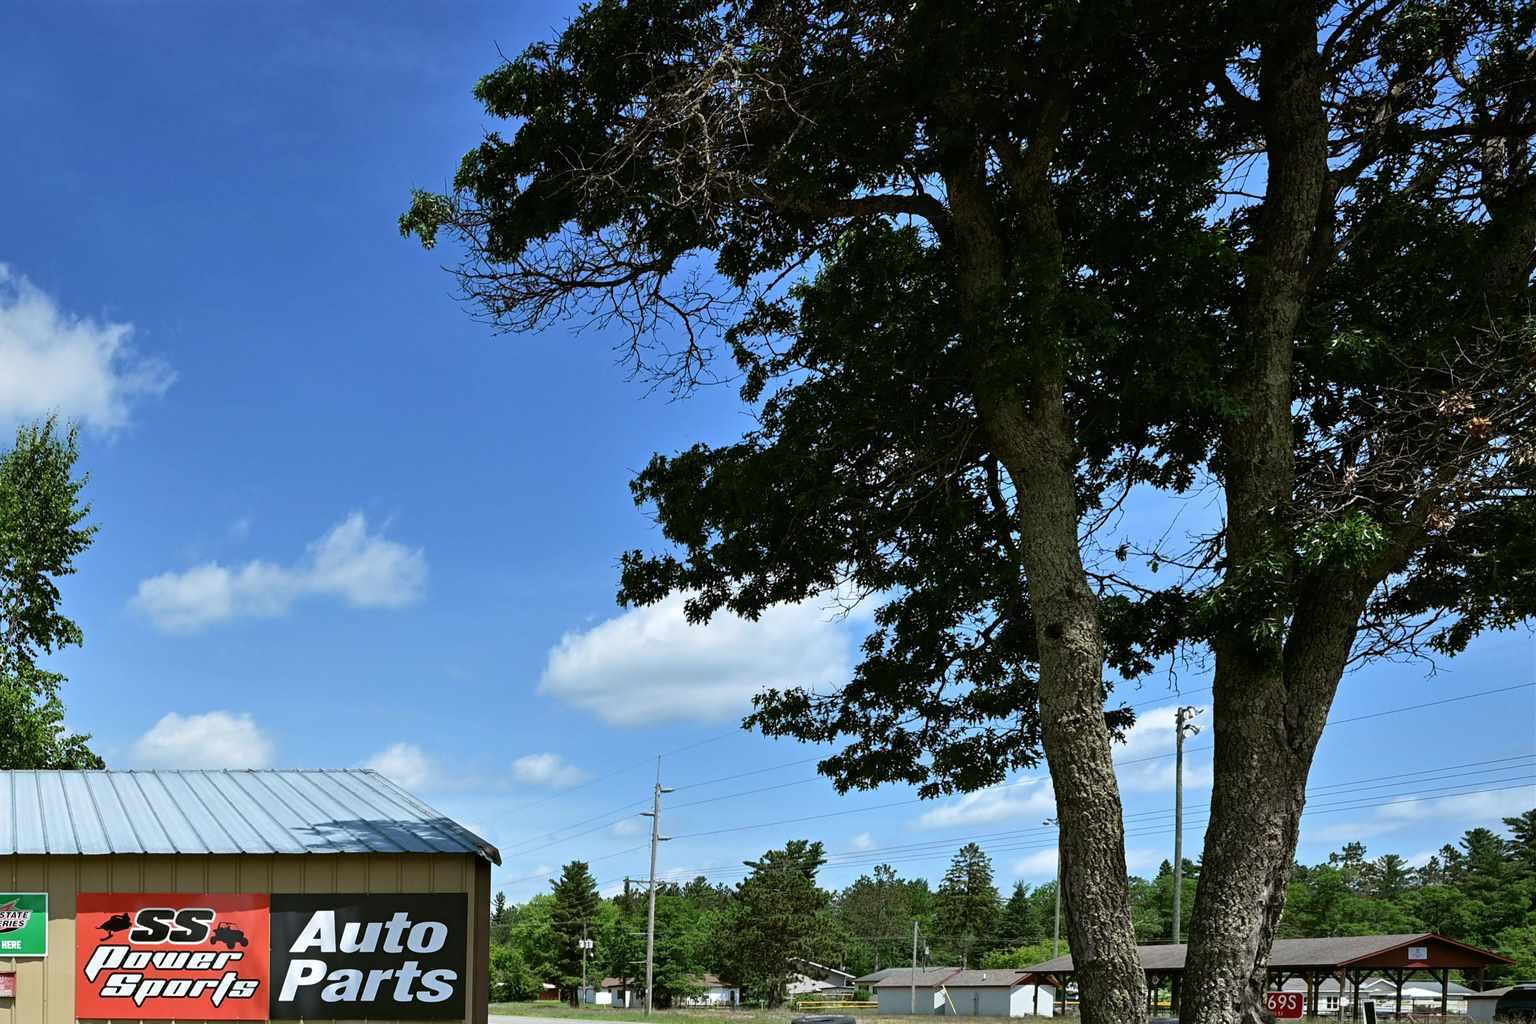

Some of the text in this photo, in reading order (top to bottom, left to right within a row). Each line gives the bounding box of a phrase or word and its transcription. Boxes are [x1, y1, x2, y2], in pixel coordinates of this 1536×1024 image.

[129, 907, 216, 944] SS
[289, 910, 449, 954] Auto
[1, 940, 22, 949] HERE
[84, 945, 244, 982] Power
[278, 959, 458, 1003] Parts
[99, 972, 261, 1008] Sports
